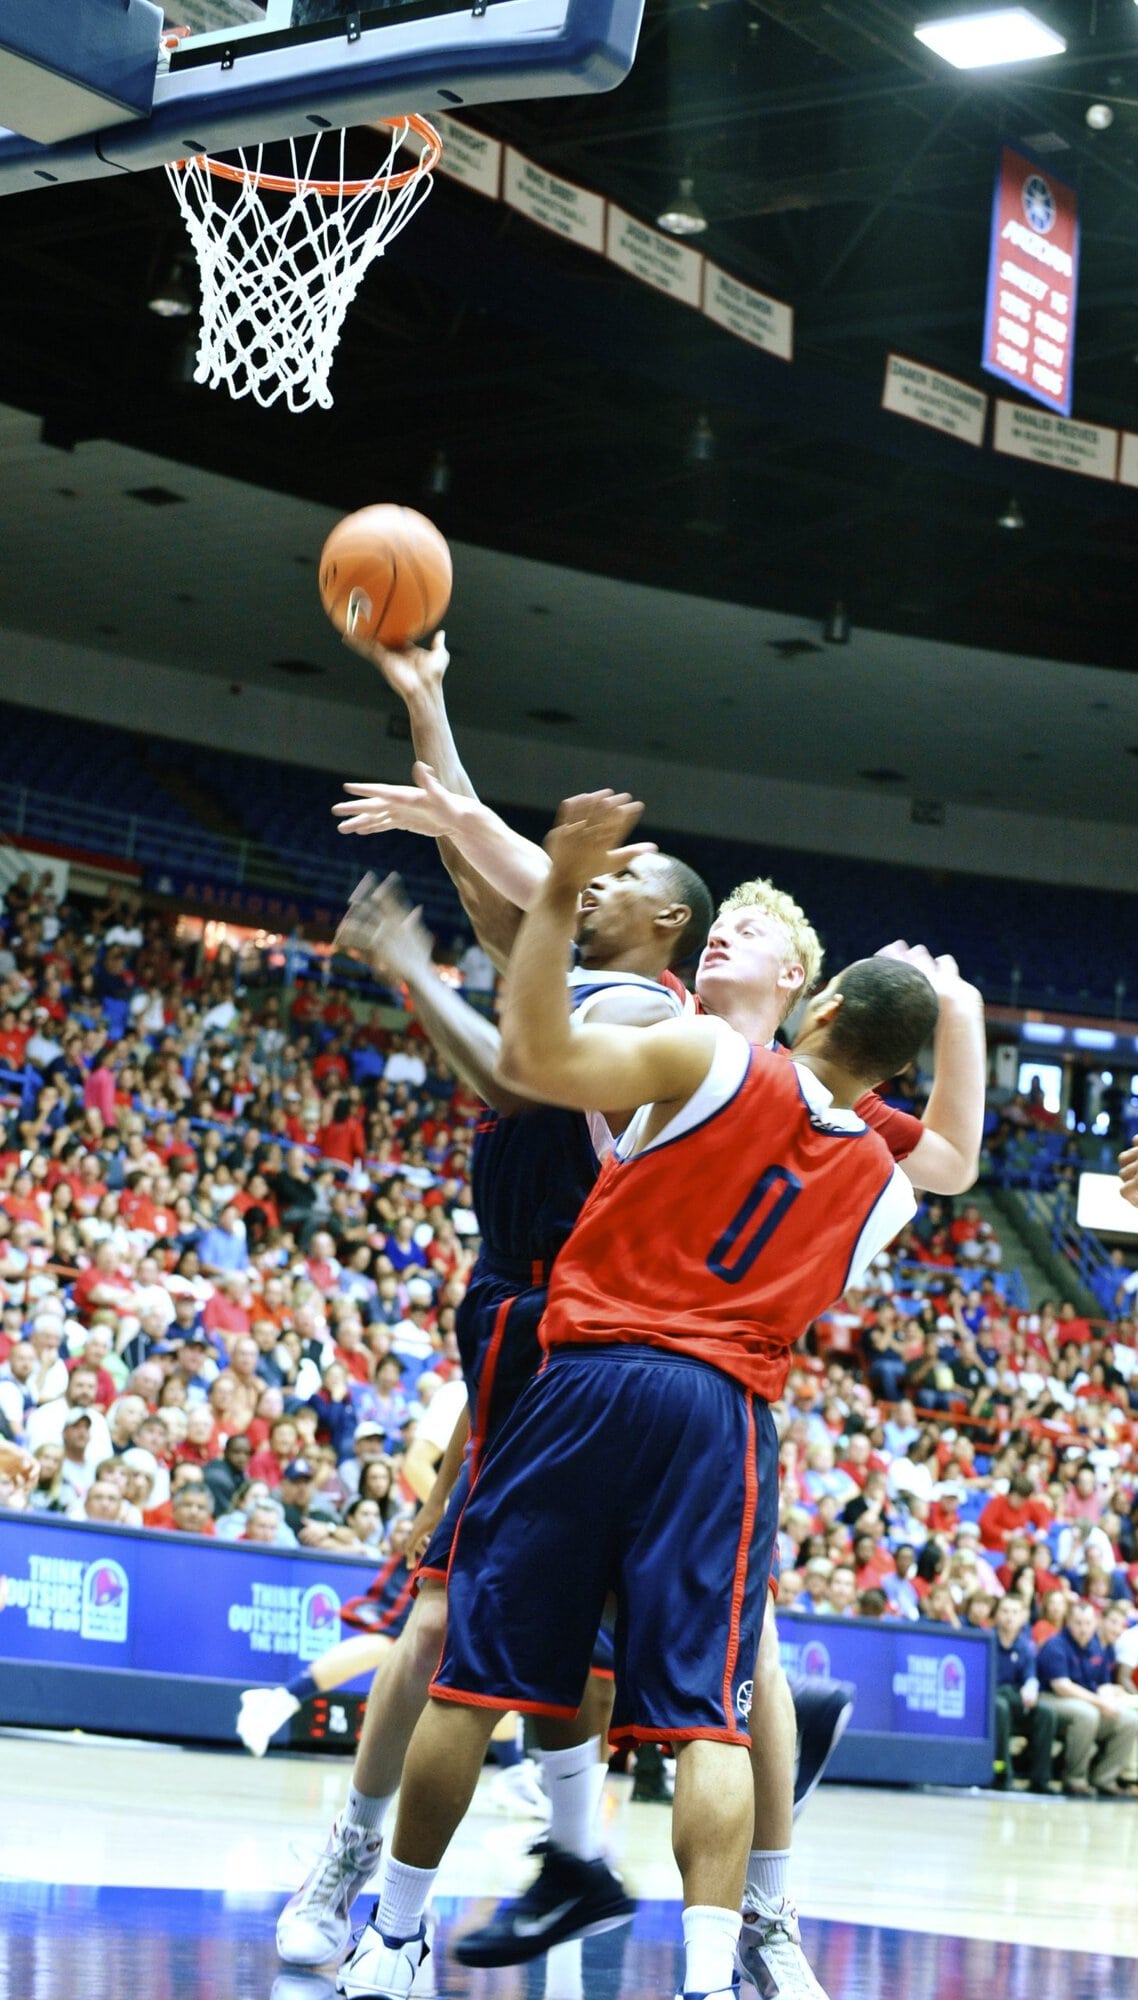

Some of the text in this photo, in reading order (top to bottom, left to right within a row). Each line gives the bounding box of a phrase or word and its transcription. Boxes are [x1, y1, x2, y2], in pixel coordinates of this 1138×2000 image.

[706, 1164, 804, 1285] 0
[28, 1554, 83, 1586] THINK
[251, 1582, 300, 1610] THINK
[27, 1606, 52, 1629] THE
[228, 1603, 300, 1635] OUTSIDE
[249, 1631, 272, 1653] THE
